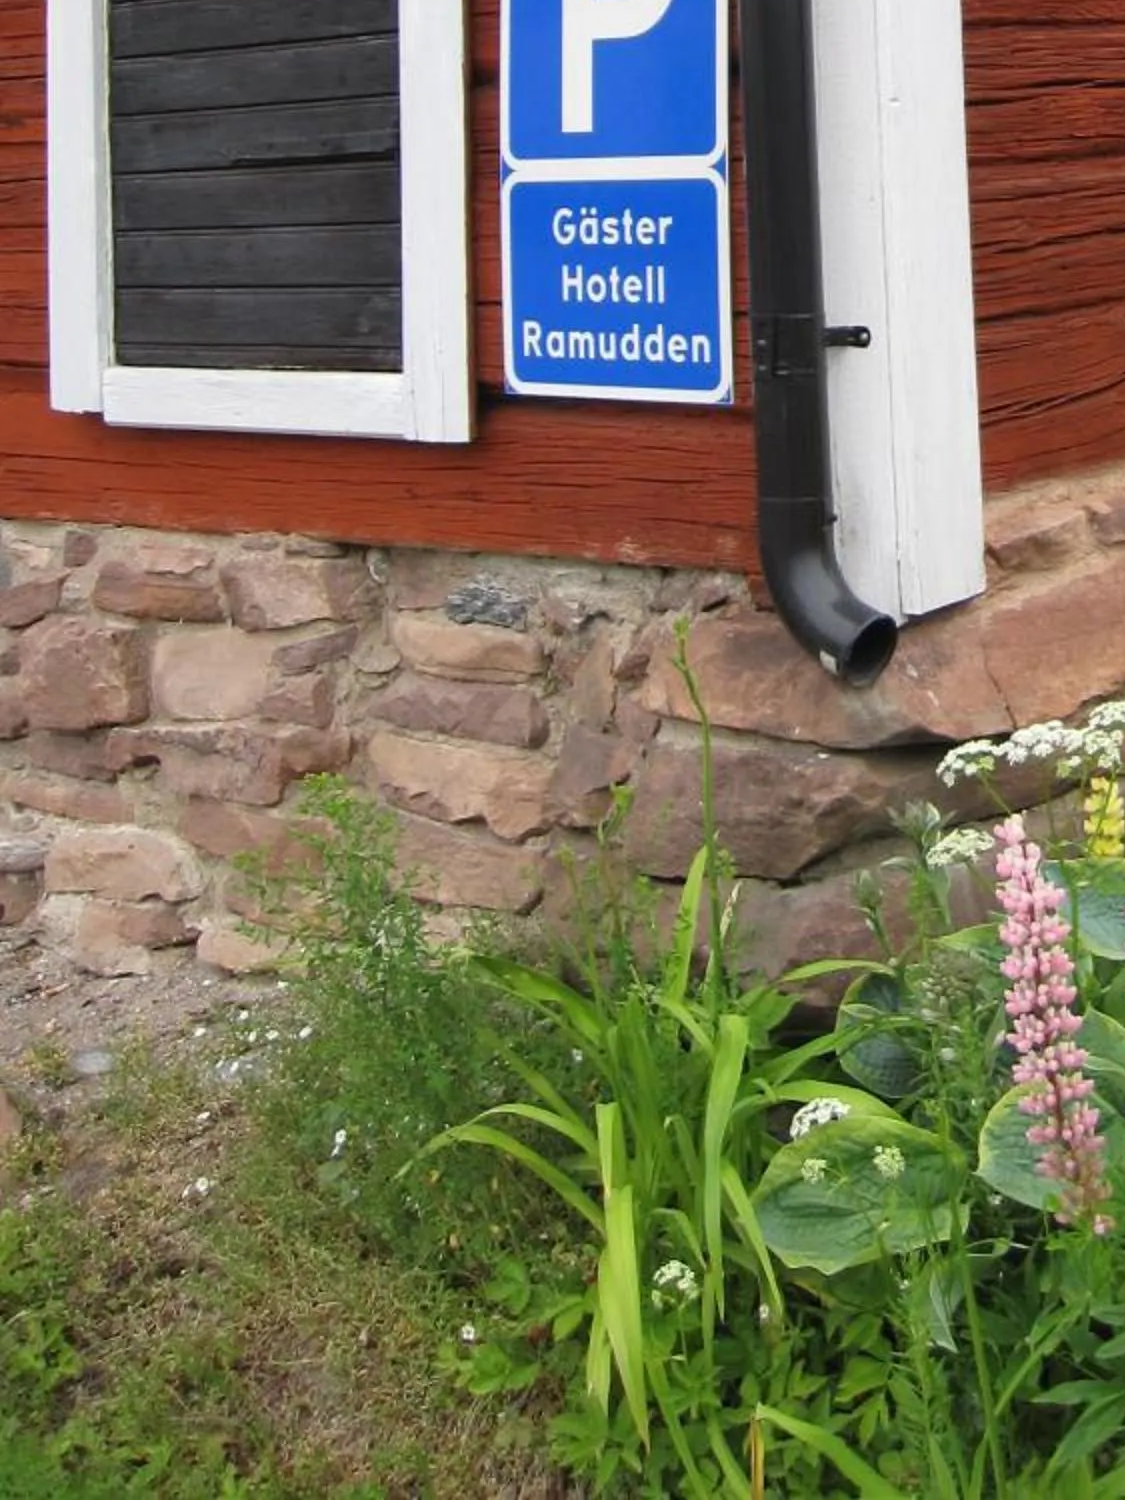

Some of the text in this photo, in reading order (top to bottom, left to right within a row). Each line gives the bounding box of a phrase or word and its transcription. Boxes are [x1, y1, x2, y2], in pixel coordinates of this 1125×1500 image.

[552, 207, 673, 246] Gäster
[561, 265, 665, 303] Hotell
[522, 321, 711, 363] Ramudden
